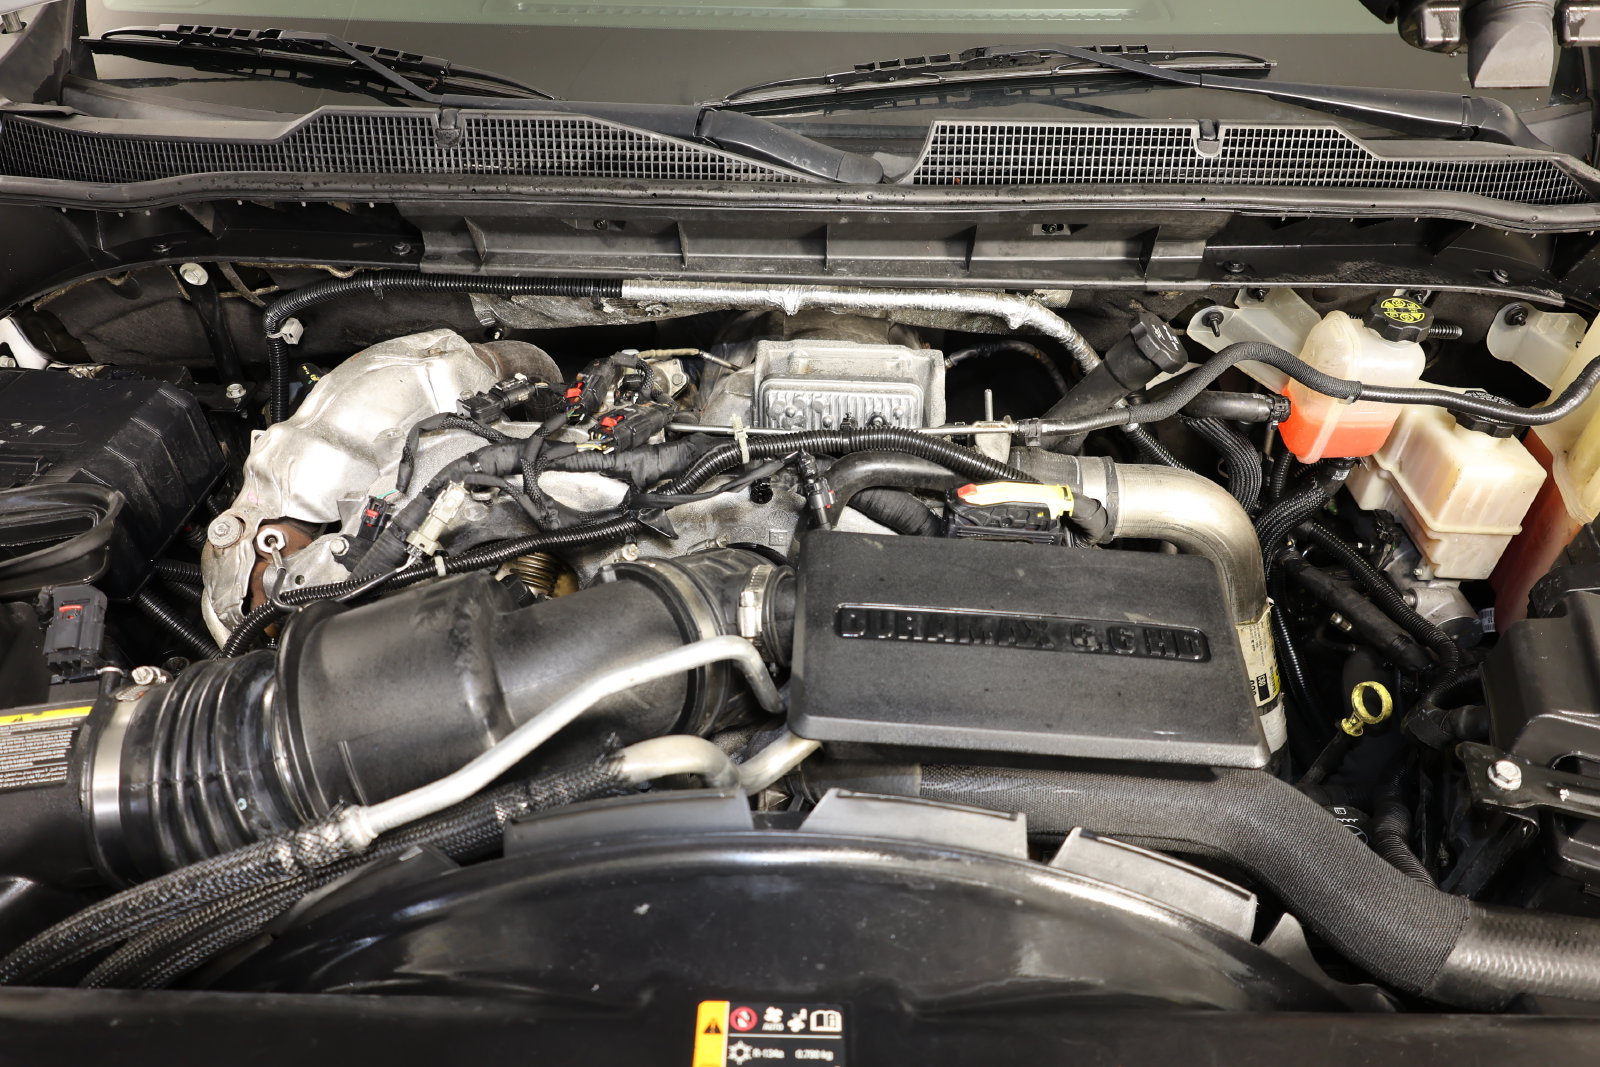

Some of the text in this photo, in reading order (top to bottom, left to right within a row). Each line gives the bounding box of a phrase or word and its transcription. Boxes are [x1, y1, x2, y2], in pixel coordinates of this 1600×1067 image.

[841, 607, 1205, 660] DURAMAX 6.6 HD
